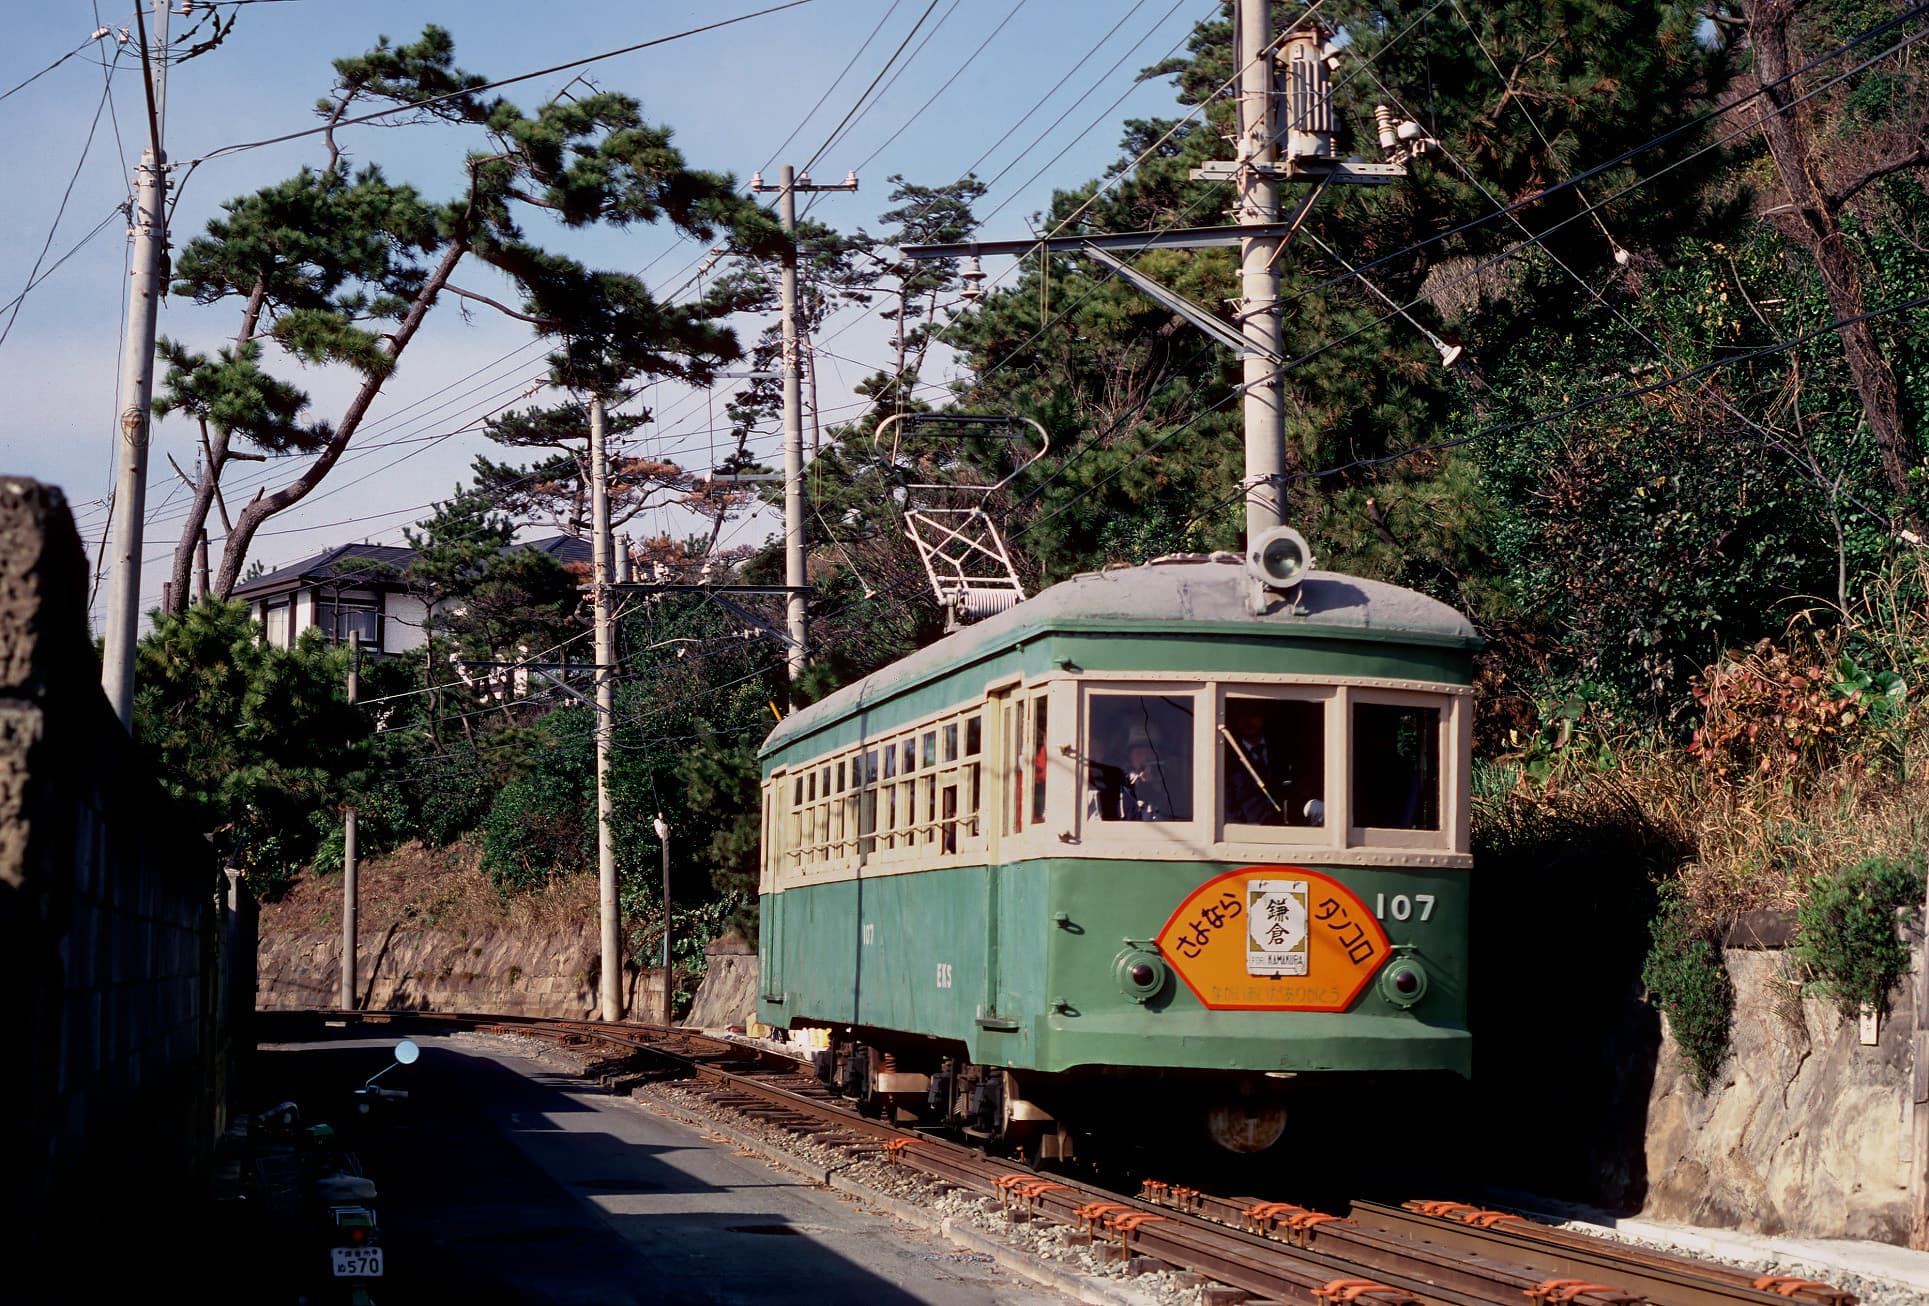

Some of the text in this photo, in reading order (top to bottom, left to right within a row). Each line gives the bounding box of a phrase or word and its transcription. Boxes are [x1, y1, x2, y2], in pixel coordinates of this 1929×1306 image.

[1176, 892, 1243, 959] さよなら
[1265, 898, 1290, 945] 鎌倉
[1377, 893, 1436, 921] 107
[863, 924, 875, 945] 107
[1314, 897, 1375, 965] タンコロ
